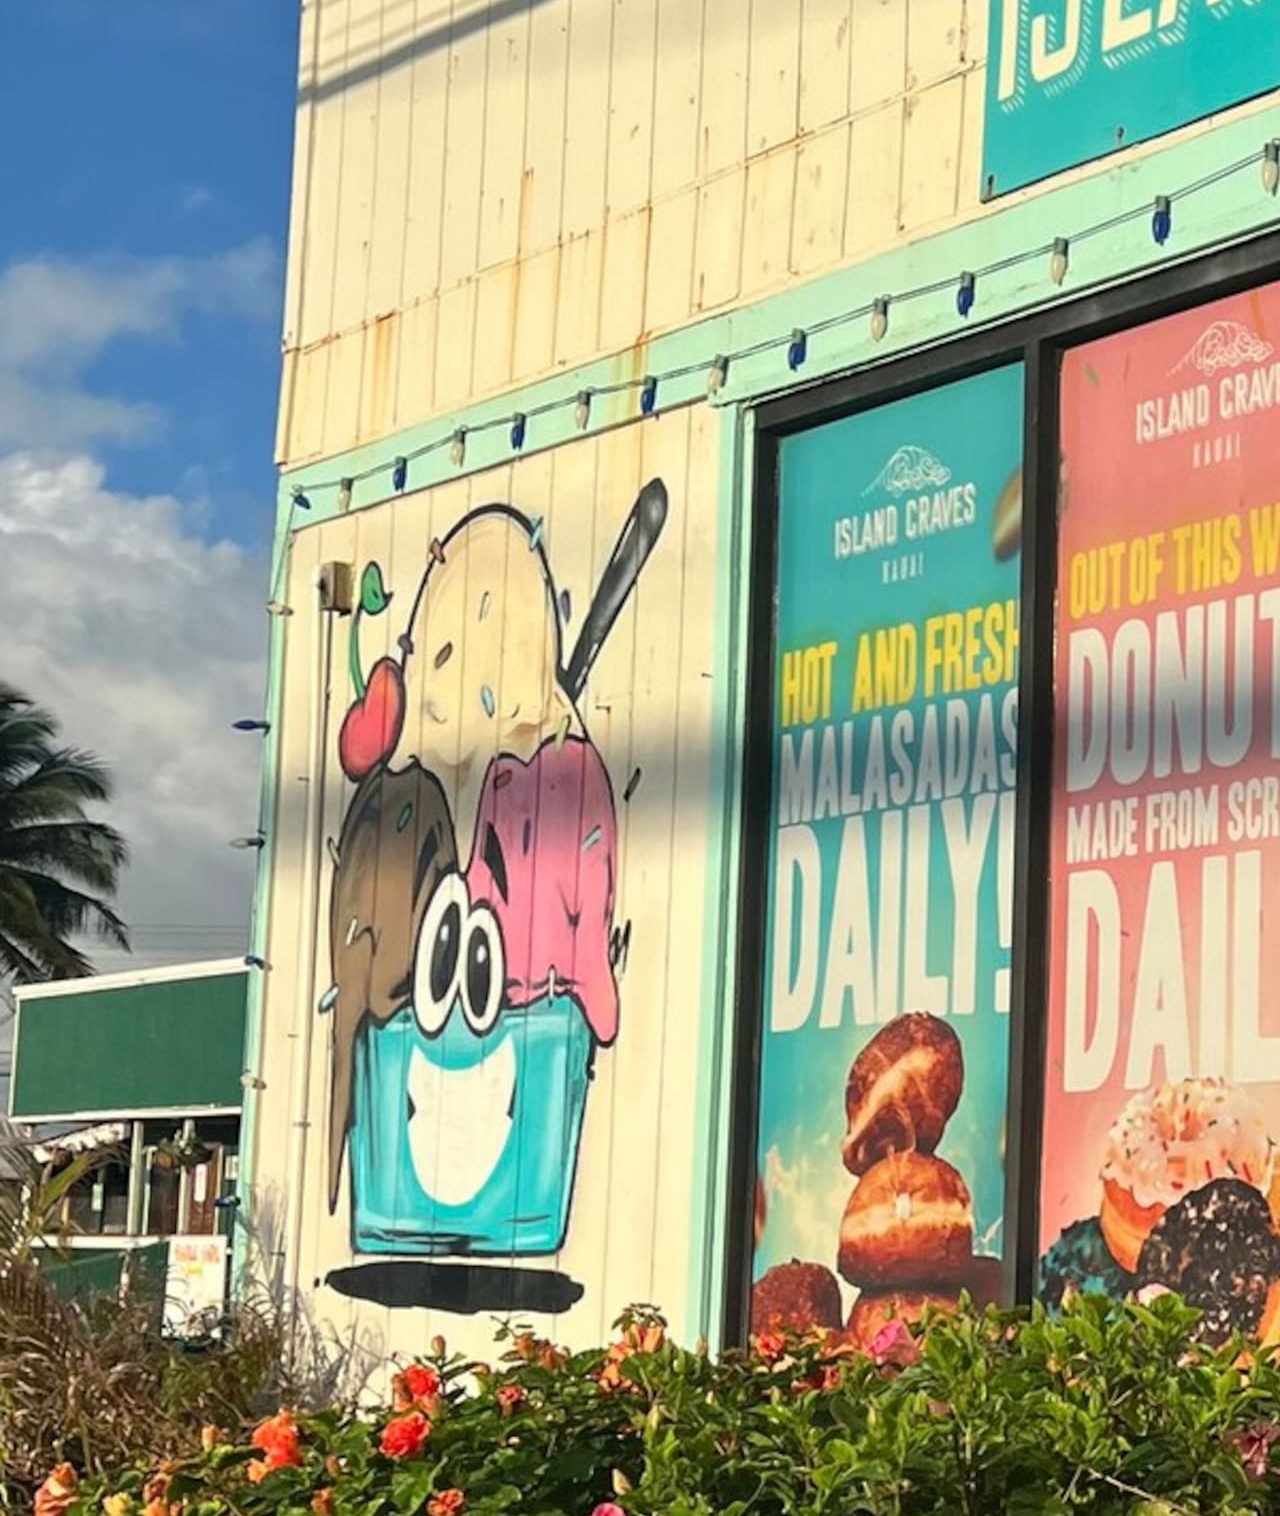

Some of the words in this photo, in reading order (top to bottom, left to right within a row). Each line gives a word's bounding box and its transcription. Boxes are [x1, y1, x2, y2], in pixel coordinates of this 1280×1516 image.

[1136, 384, 1210, 444] ISLAND
[834, 505, 898, 560] ISLAND
[905, 482, 976, 539] CRAVES
[1070, 541, 1126, 619] OUT
[1128, 531, 1165, 606] OF
[1172, 513, 1242, 595] THIS
[782, 641, 838, 727] HOT
[852, 623, 918, 713] AND
[924, 599, 1019, 698] FRESH
[778, 686, 1019, 826] MALASADAS
[1067, 798, 1138, 864] MADE
[1145, 784, 1219, 856] FROM
